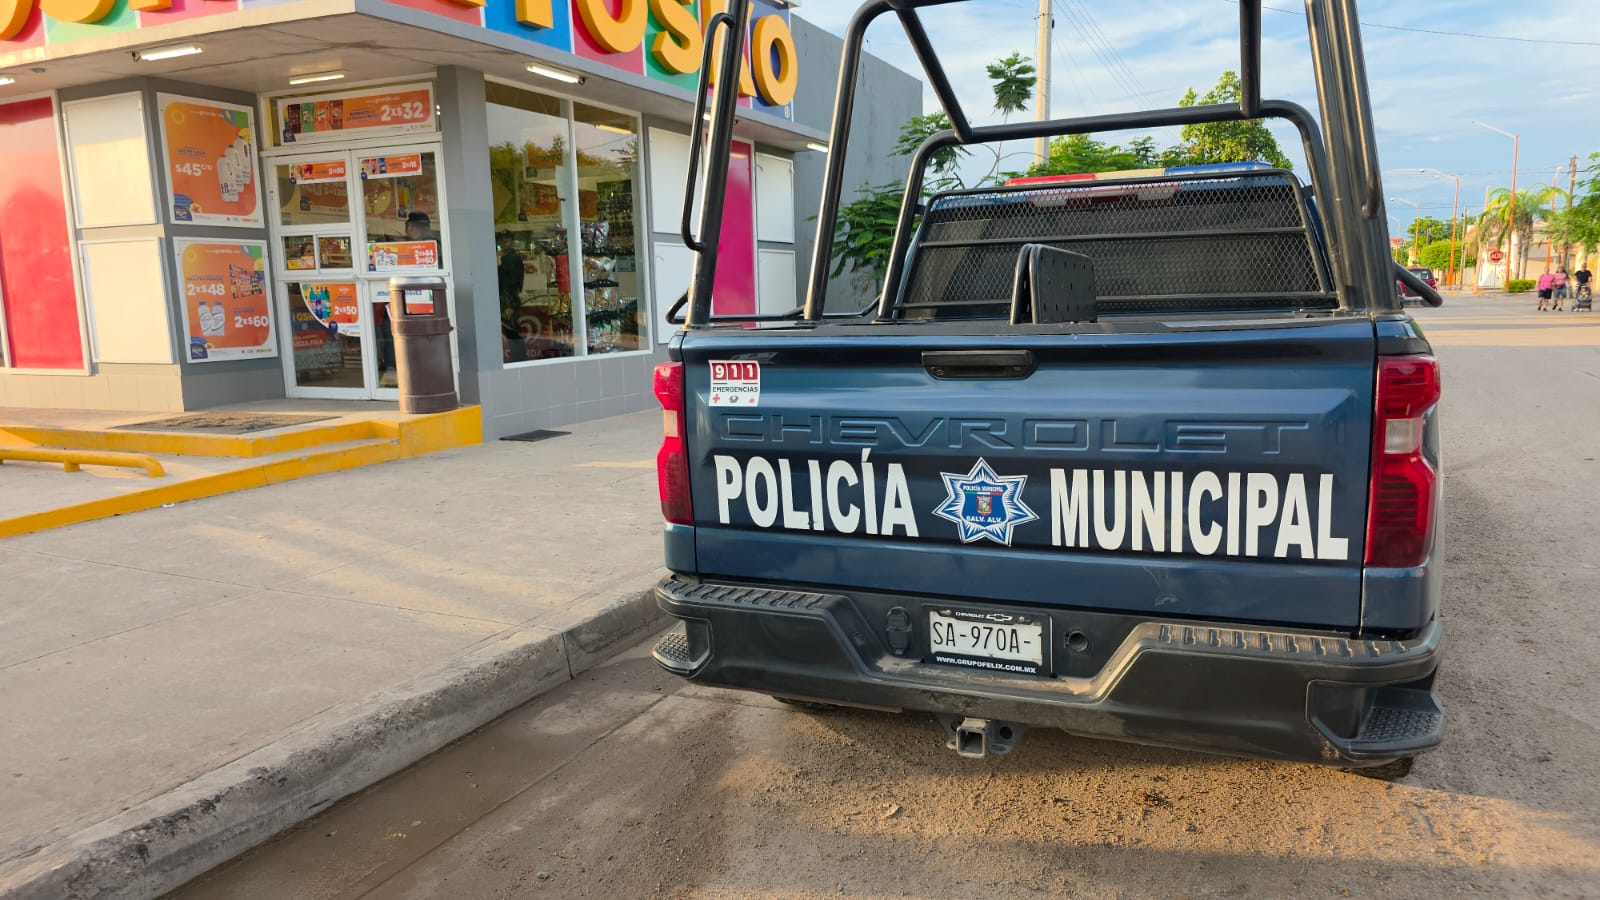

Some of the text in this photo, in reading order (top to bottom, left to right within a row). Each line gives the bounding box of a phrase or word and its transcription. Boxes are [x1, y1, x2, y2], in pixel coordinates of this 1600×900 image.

[175, 163, 202, 177] $45
[715, 363, 754, 379] 911
[719, 412, 1309, 455] CHEVROLET
[713, 447, 1350, 561] POLICÍA MUNICIPAL
[936, 655, 1037, 674] WWW.GRUPOFELIX.COM.MX
